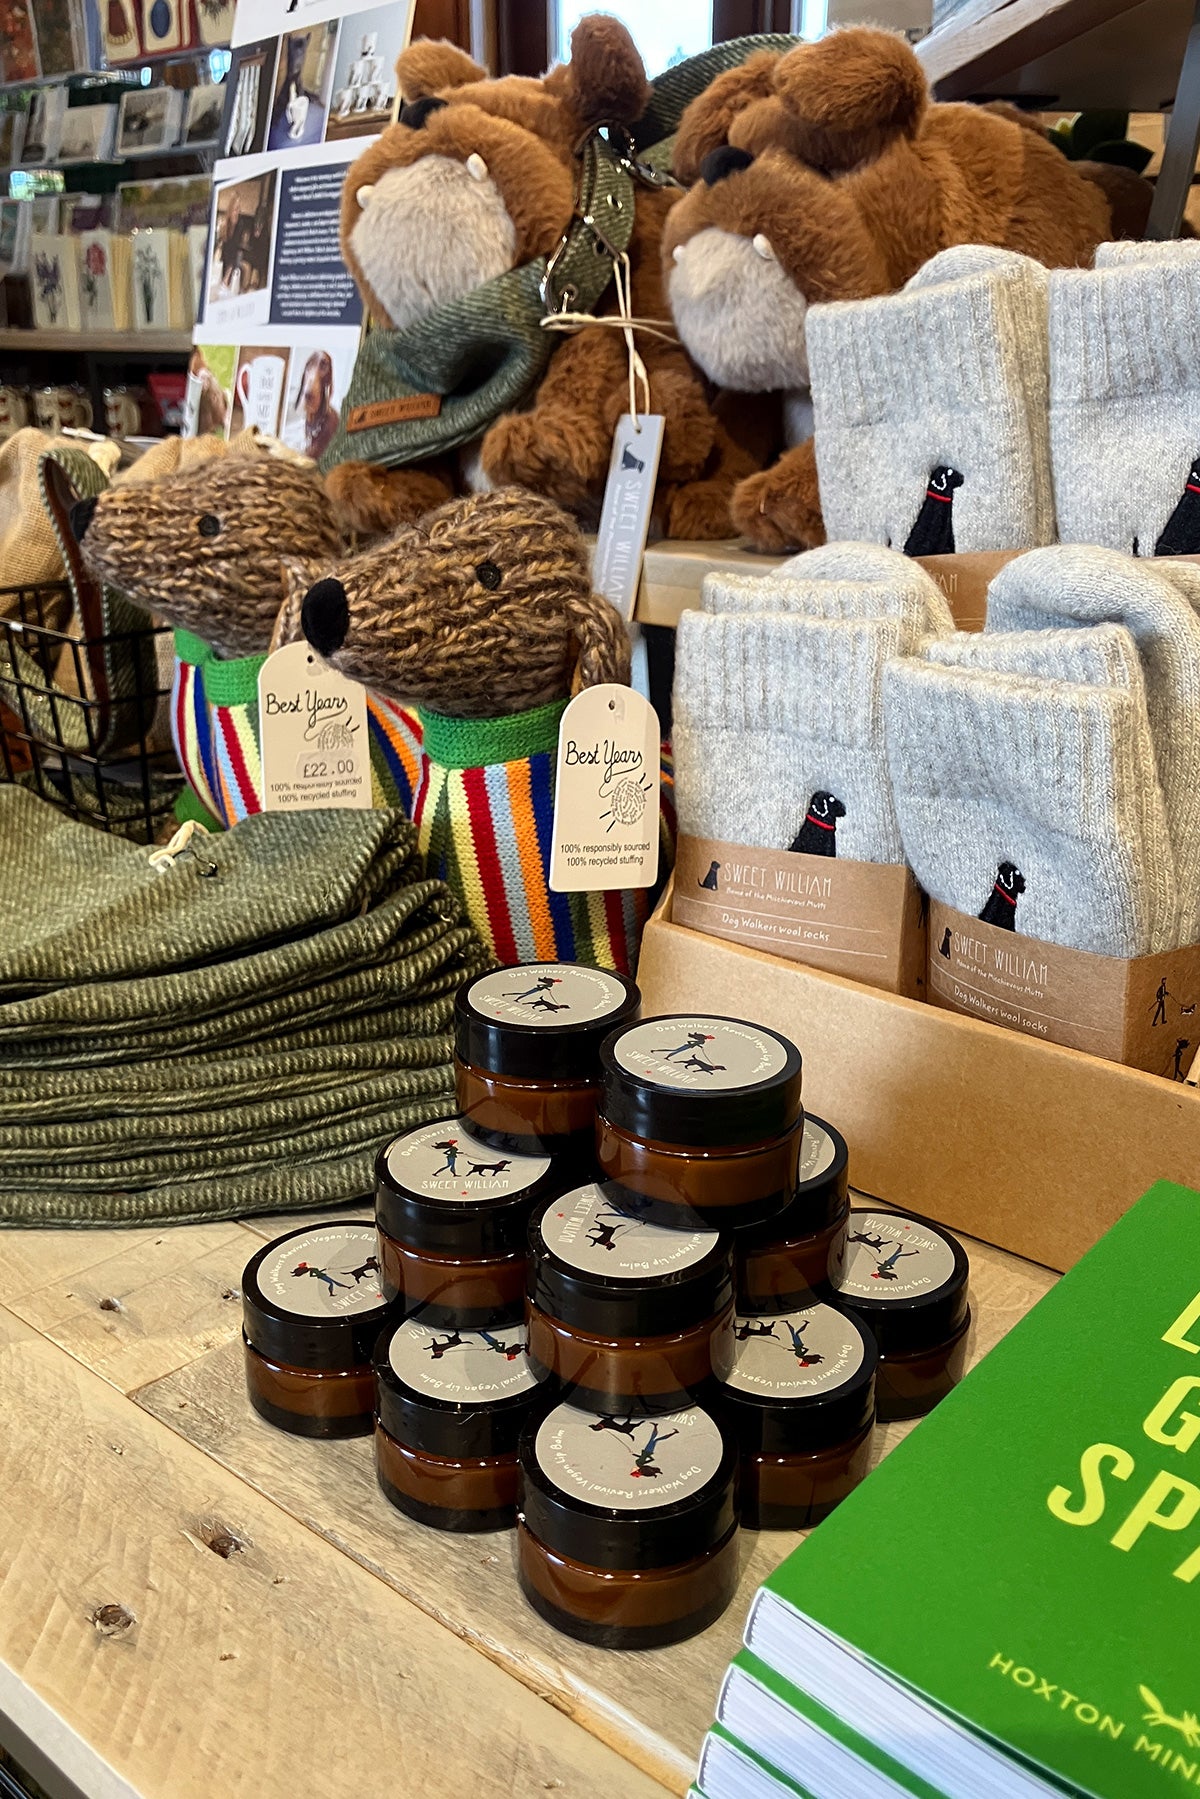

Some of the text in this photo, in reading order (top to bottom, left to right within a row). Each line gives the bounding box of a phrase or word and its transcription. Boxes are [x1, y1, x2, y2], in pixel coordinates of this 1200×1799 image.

[619, 480, 642, 530] SWEET
[266, 689, 348, 728] Best Years
[304, 759, 354, 778] £22.00
[565, 739, 643, 784] Best Years
[270, 783, 291, 792] 100%
[278, 788, 357, 803] 100% recycled stuffing
[560, 842, 651, 854] 100% responsibly sourced
[566, 855, 644, 867] 100% recycled stuffing
[723, 862, 832, 898] SWEET WILLIAM
[754, 890, 765, 900] the
[766, 893, 806, 907] Mischievous
[806, 901, 827, 910] Mutts
[722, 913, 830, 942] Dog Walkers wool socks
[953, 931, 1048, 986] SWEET WILLIAM
[977, 967, 987, 978] the
[987, 972, 1025, 993] Mischievous
[1024, 986, 1044, 999] Mutts
[954, 985, 1049, 1034] Dog Walkers wool socks
[655, 1025, 676, 1033] Dog
[626, 1050, 660, 1068] SWEET
[421, 1179, 510, 1190] SWEET WILLIAM
[863, 1218, 939, 1252] SWEET WILLIAM
[280, 1240, 312, 1259] Revival
[311, 1234, 342, 1243] Vegan
[345, 1232, 359, 1240] Lip
[360, 1233, 378, 1243] Bal
[873, 1283, 914, 1293] Walkers
[911, 1276, 932, 1287] Dog
[332, 1290, 366, 1311] SWEET
[836, 1343, 853, 1362] Dog
[741, 1371, 773, 1388] Vegan
[817, 1358, 850, 1382] Walkers
[420, 1372, 444, 1389] Balm
[445, 1382, 461, 1392] Lip
[464, 1381, 500, 1392] Vegan
[775, 1377, 818, 1389] Revival
[549, 1428, 702, 1500] Dog Walkers Revival Vegan Lip Balm
[988, 1652, 1126, 1740] HOXTON
